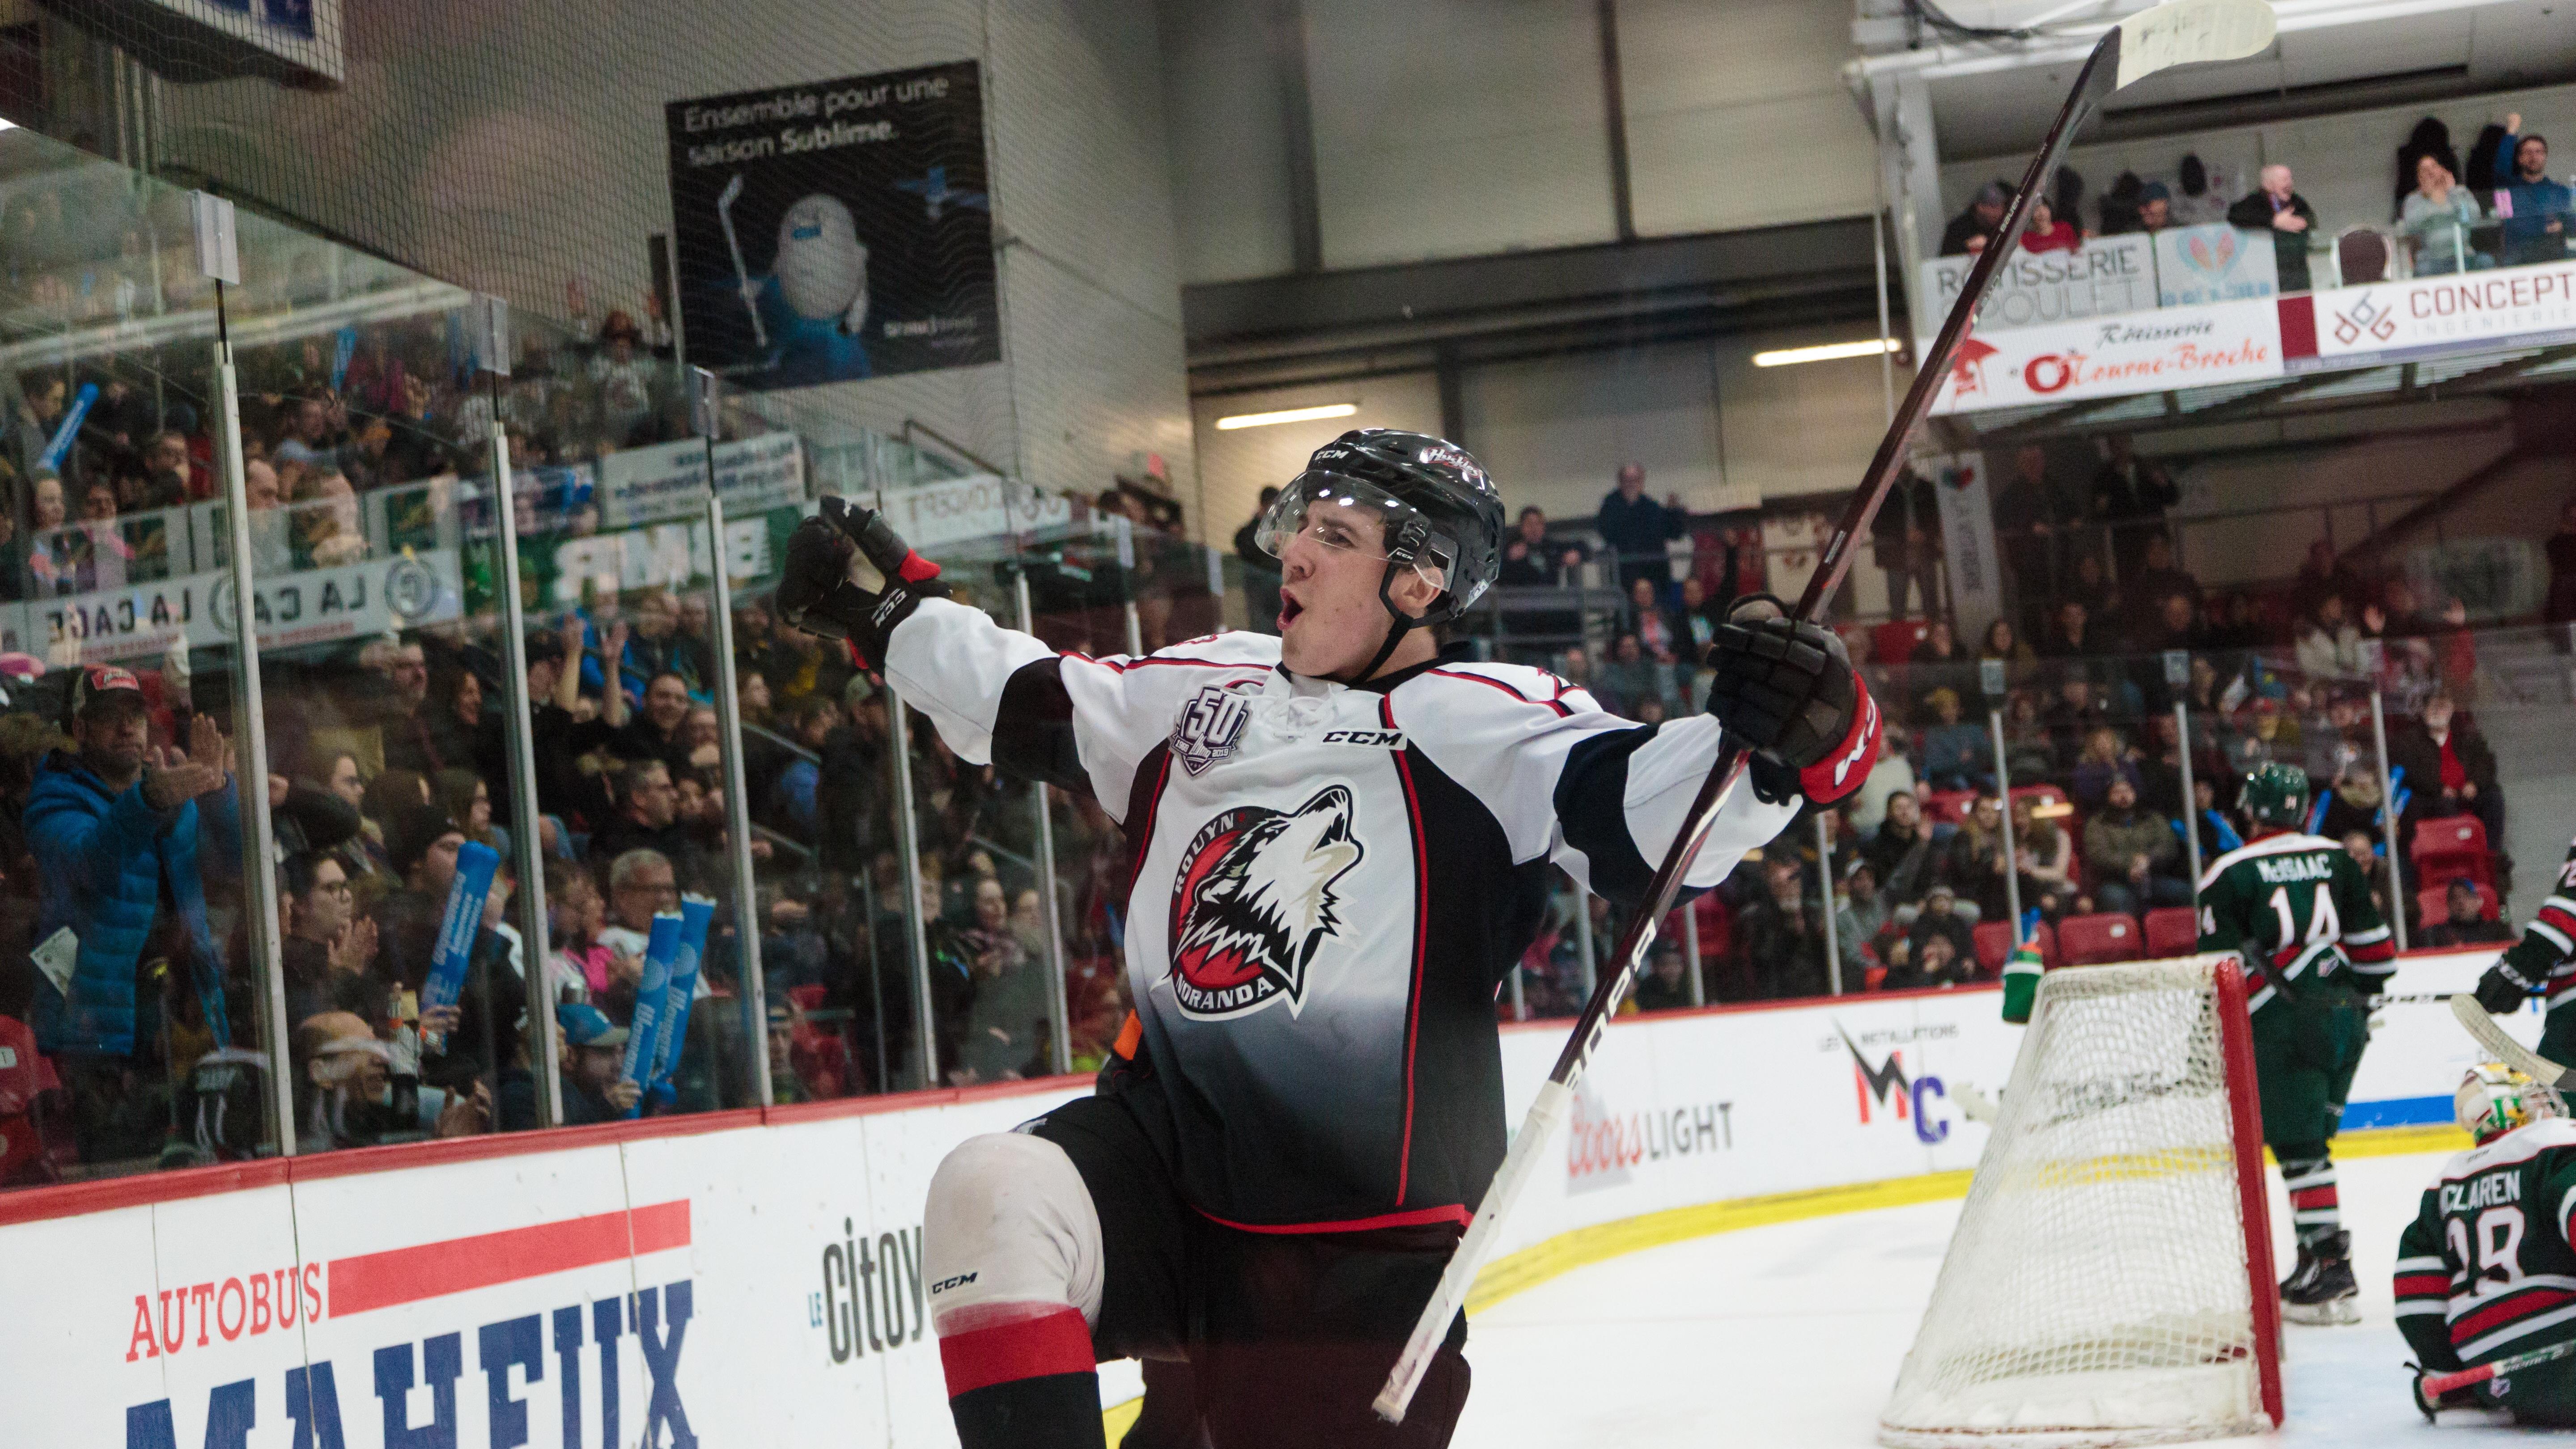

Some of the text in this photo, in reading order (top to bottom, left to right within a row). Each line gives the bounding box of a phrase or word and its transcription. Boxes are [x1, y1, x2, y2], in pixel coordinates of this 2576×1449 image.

[684, 75, 949, 132] Ensemble pour une
[689, 120, 900, 168] saison Sublime.
[1938, 245, 2137, 295] RISSERIE
[2410, 271, 2576, 319] CONCEPT
[1315, 449, 1350, 461] CCM
[1427, 448, 1479, 477] Huskies
[1396, 551, 1413, 560] CCM
[875, 590, 908, 629] CCM
[1186, 687, 1246, 745] 50
[1322, 730, 1402, 746] CCM
[1211, 748, 1229, 758] 2019
[1175, 812, 1234, 894] ROUYN
[2269, 882, 2341, 948] 14
[1175, 976, 1276, 1009] NORANDA
[1567, 1094, 1733, 1178] Coors LIGHT
[931, 1271, 978, 1294] CCM
[126, 1262, 321, 1363] AUTOBUS
